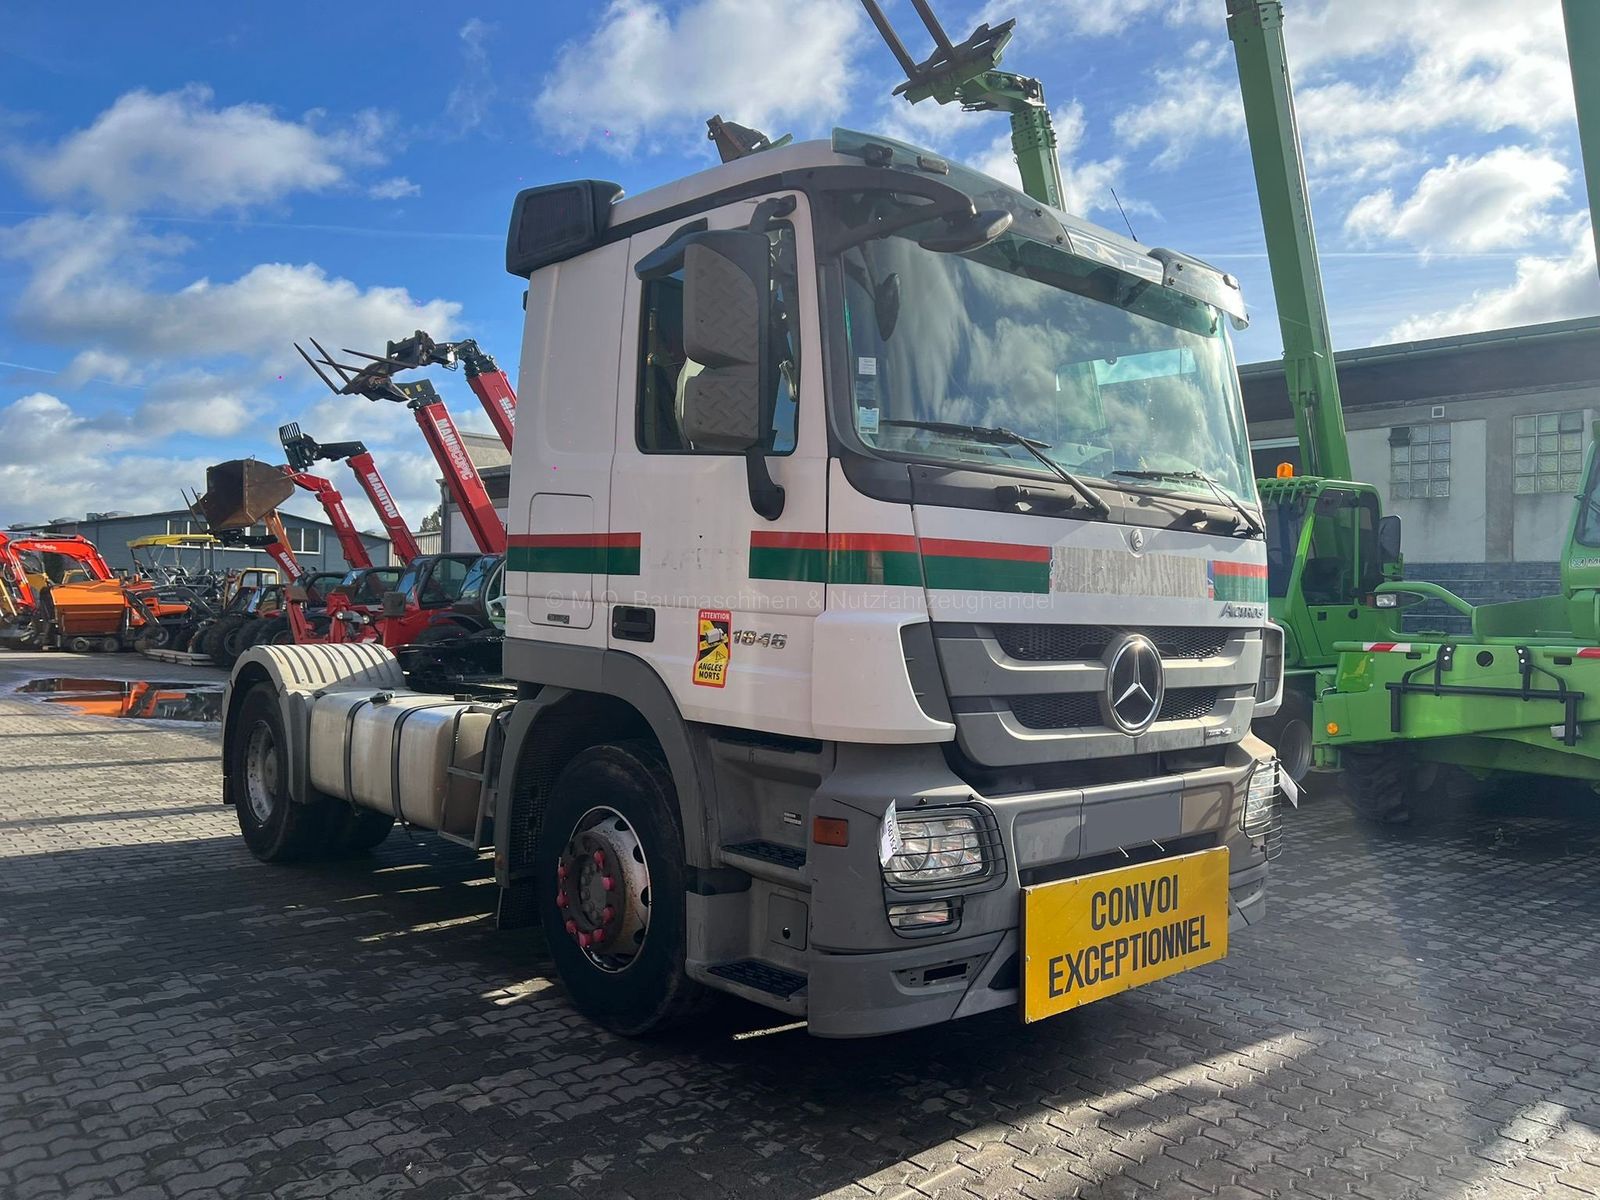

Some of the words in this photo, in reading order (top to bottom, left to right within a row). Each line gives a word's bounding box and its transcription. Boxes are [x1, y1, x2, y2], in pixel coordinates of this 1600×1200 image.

[436, 417, 474, 480] MANISCOPIC
[366, 471, 398, 519] MANITOU
[279, 551, 301, 577] MANITOU
[700, 612, 730, 620] ATTENTION
[732, 629, 788, 650] 1846
[698, 662, 722, 671] ANGLES
[698, 671, 720, 680] MORTS
[1091, 874, 1178, 931] CONVOI
[1049, 915, 1210, 999] EXCEPTIONNEL
